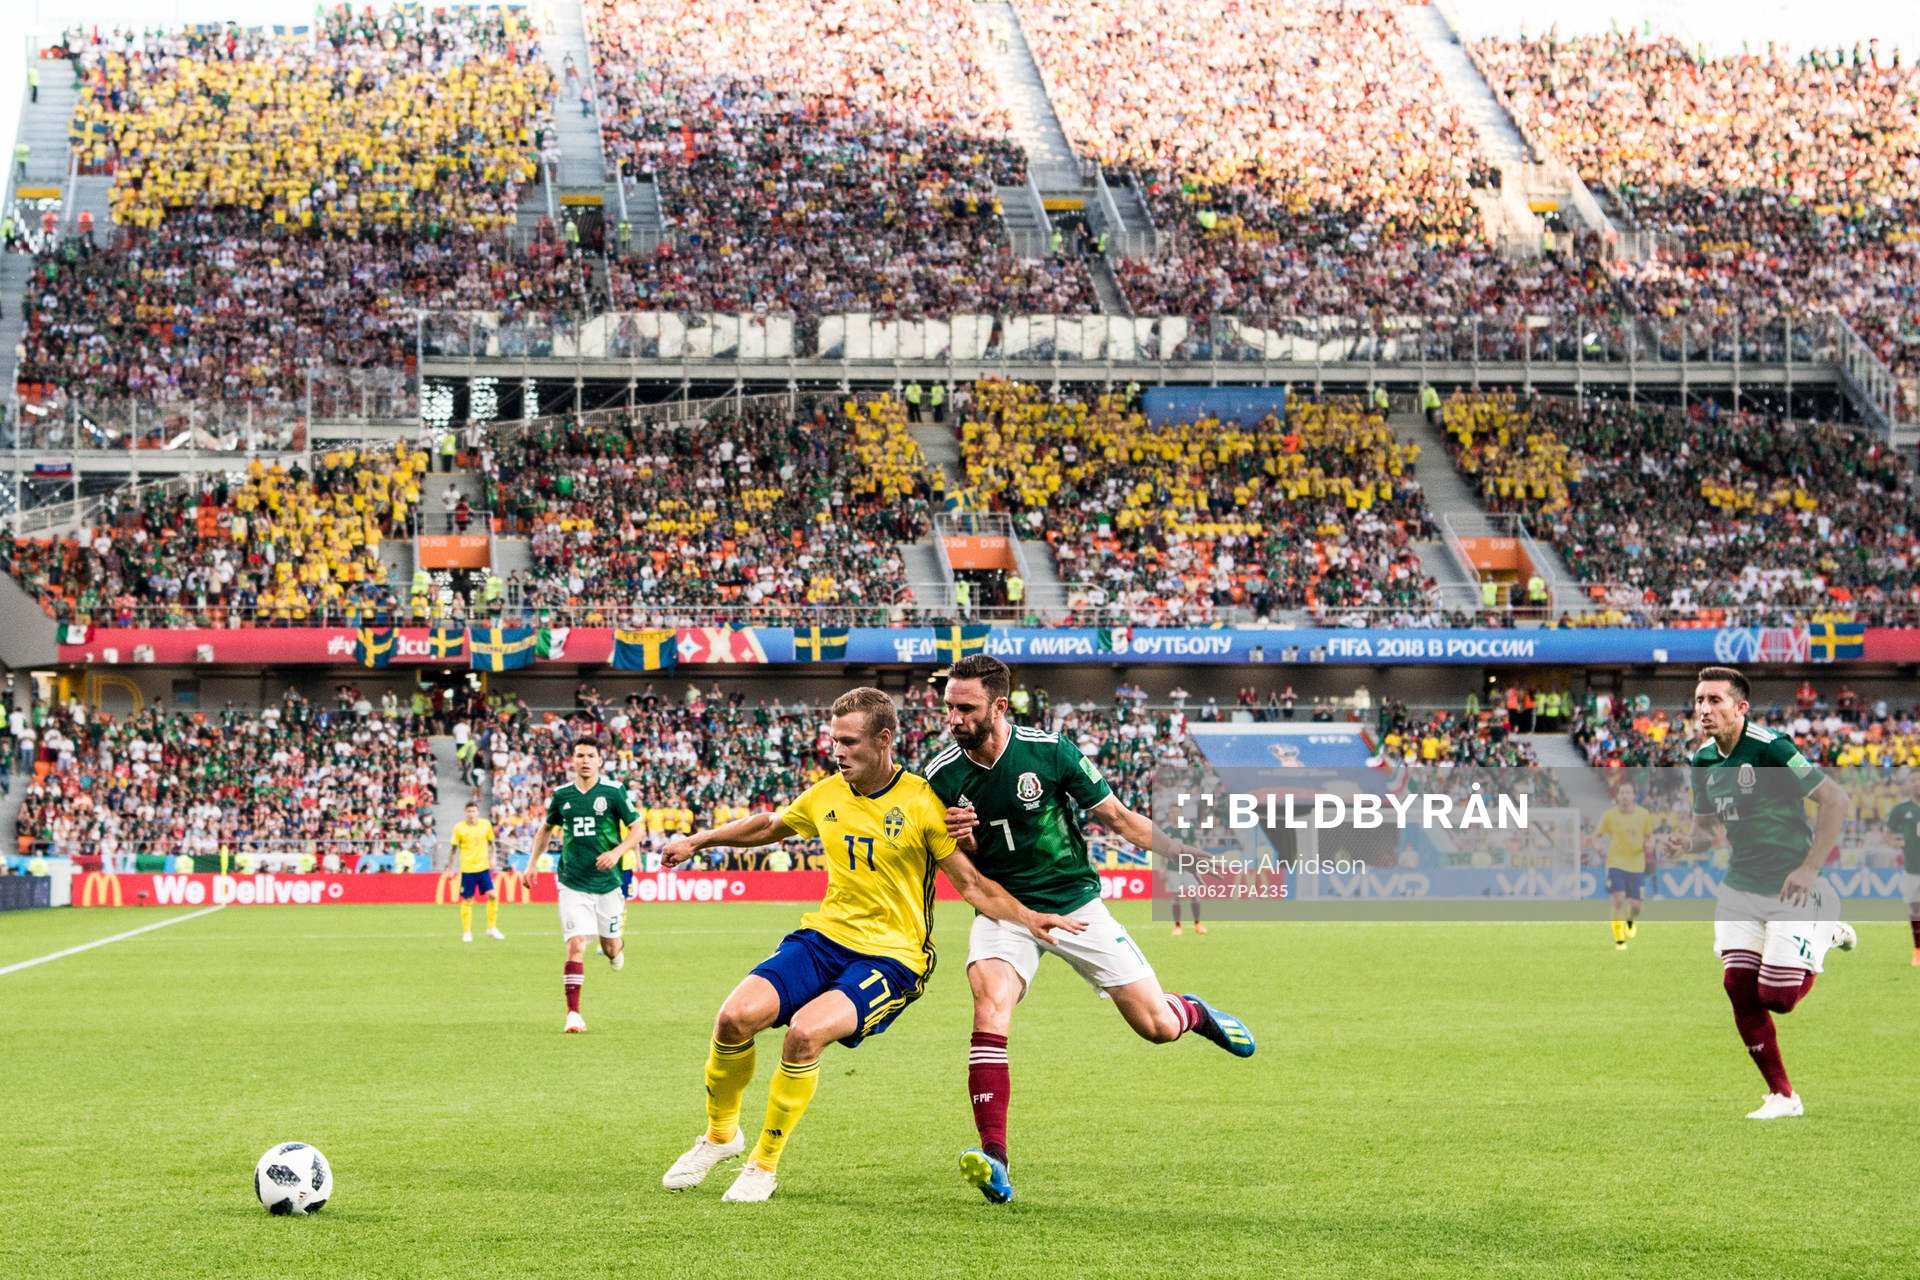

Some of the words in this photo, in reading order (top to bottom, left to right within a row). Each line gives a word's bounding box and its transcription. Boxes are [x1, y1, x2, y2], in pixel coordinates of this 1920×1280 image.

[1030, 637, 1092, 655] МИРА
[1133, 636, 1232, 655] ФУТБОЛУ
[1328, 638, 1373, 656] FIFA
[1377, 638, 1424, 656] 2018
[1428, 638, 1443, 656] В
[1447, 638, 1535, 656] РОССИИ
[573, 817, 596, 836] 22
[989, 818, 1016, 851] 7
[844, 835, 876, 872] 17
[153, 875, 206, 904] We
[212, 874, 326, 904] Deliver
[859, 969, 892, 1009] 17
[973, 1093, 994, 1105] FMF
